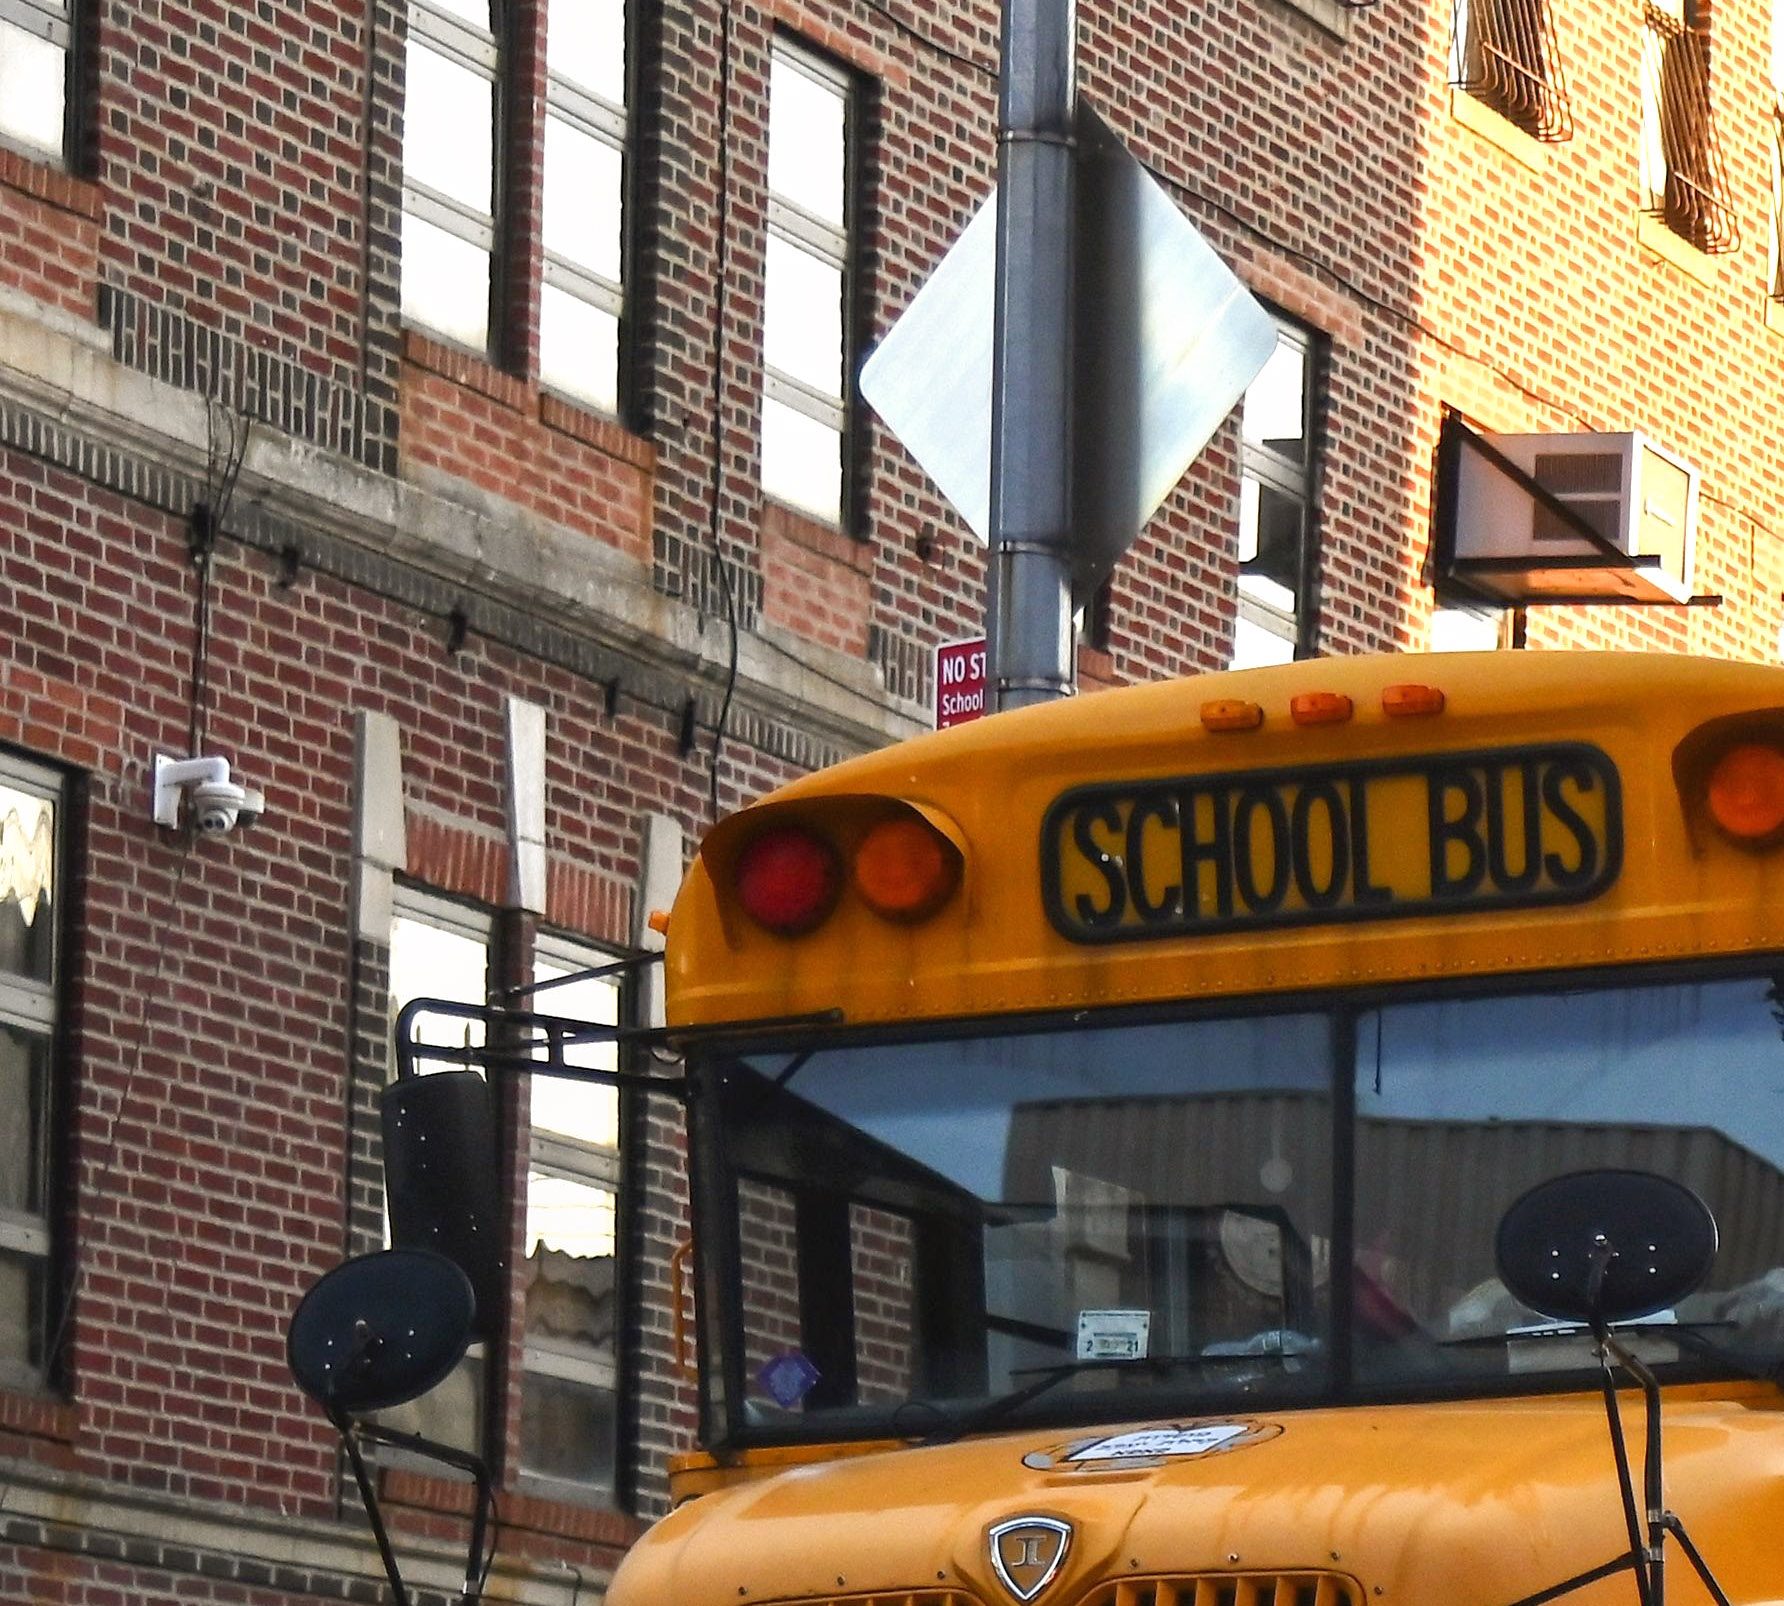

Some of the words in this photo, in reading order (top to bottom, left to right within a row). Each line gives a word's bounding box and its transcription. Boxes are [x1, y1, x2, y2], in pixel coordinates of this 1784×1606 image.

[943, 655, 966, 685] NO
[942, 689, 984, 716] School
[1073, 773, 1395, 927] SCHOOL
[1428, 762, 1596, 900] BUS
